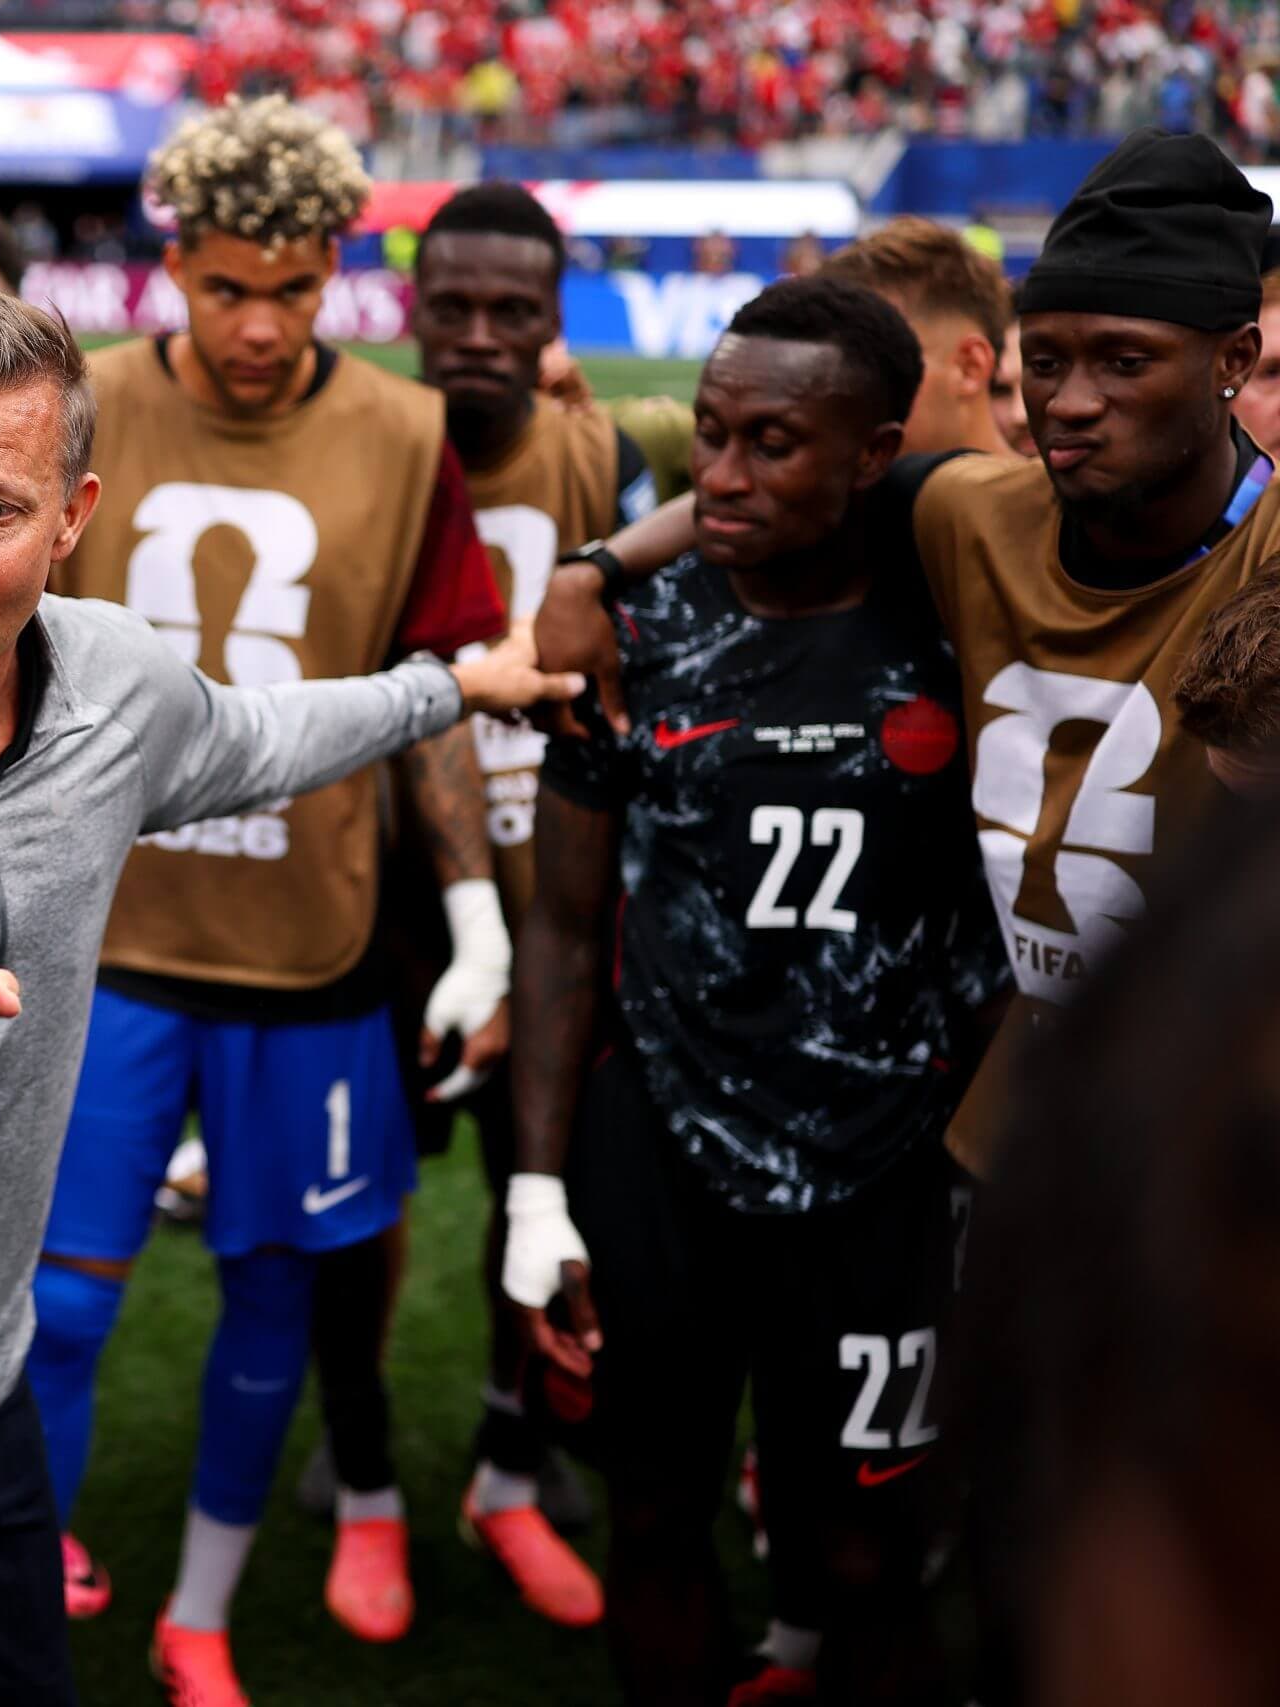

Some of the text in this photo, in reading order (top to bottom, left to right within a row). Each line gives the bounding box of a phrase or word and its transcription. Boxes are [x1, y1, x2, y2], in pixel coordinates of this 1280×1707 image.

[135, 813, 290, 861] 026
[746, 805, 864, 933] 22
[1014, 933, 1088, 981] FIFA
[325, 1080, 351, 1180] 1
[839, 1326, 939, 1450] 22
